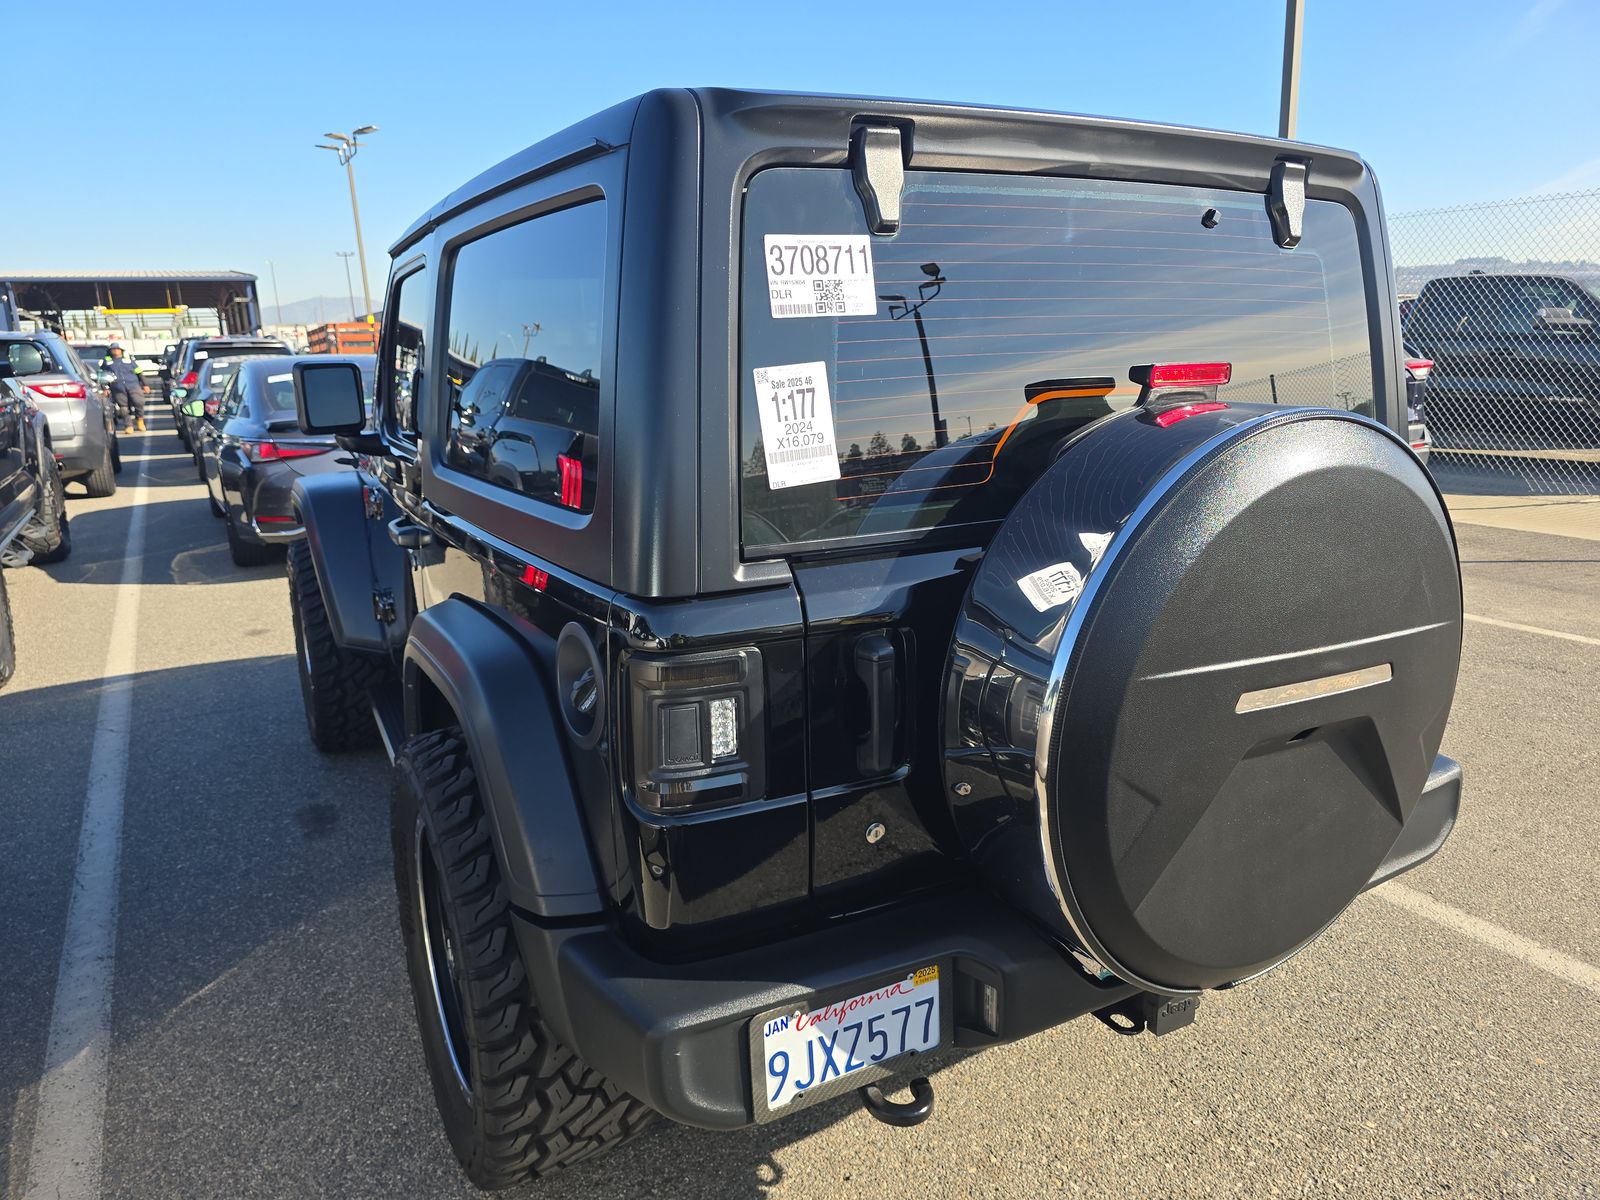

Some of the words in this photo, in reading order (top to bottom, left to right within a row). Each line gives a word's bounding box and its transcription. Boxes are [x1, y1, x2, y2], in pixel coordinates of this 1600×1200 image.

[769, 244, 869, 276] 3708711
[771, 289, 792, 299] DLR
[771, 379, 786, 389] Sale
[787, 377, 804, 388] 2025
[804, 375, 813, 386] 46
[771, 387, 815, 422] 1:177
[784, 420, 813, 436] 2024
[918, 966, 937, 979] 2025
[795, 982, 915, 1032] California
[764, 1015, 789, 1038] JAN
[768, 996, 935, 1103] 9JXZ577
